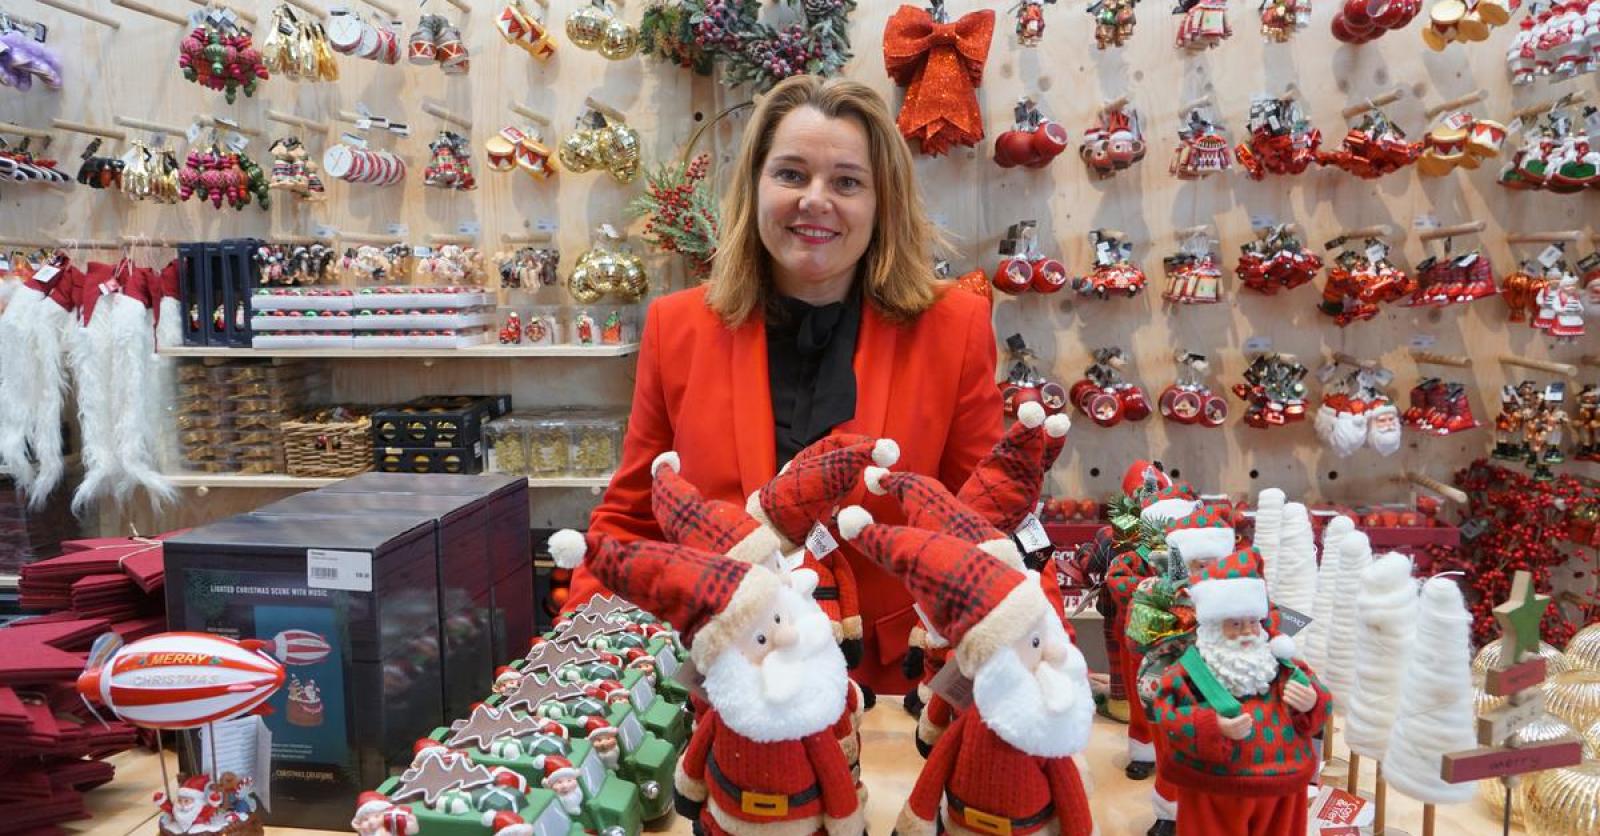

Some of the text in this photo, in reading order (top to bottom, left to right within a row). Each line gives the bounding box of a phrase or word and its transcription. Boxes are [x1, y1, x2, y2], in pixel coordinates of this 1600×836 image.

[210, 584, 328, 597] LIGHTED CHRISTMAS SCENE WITH MUSIC
[149, 653, 208, 666] MERRY
[133, 674, 220, 687] CHRISTMAS
